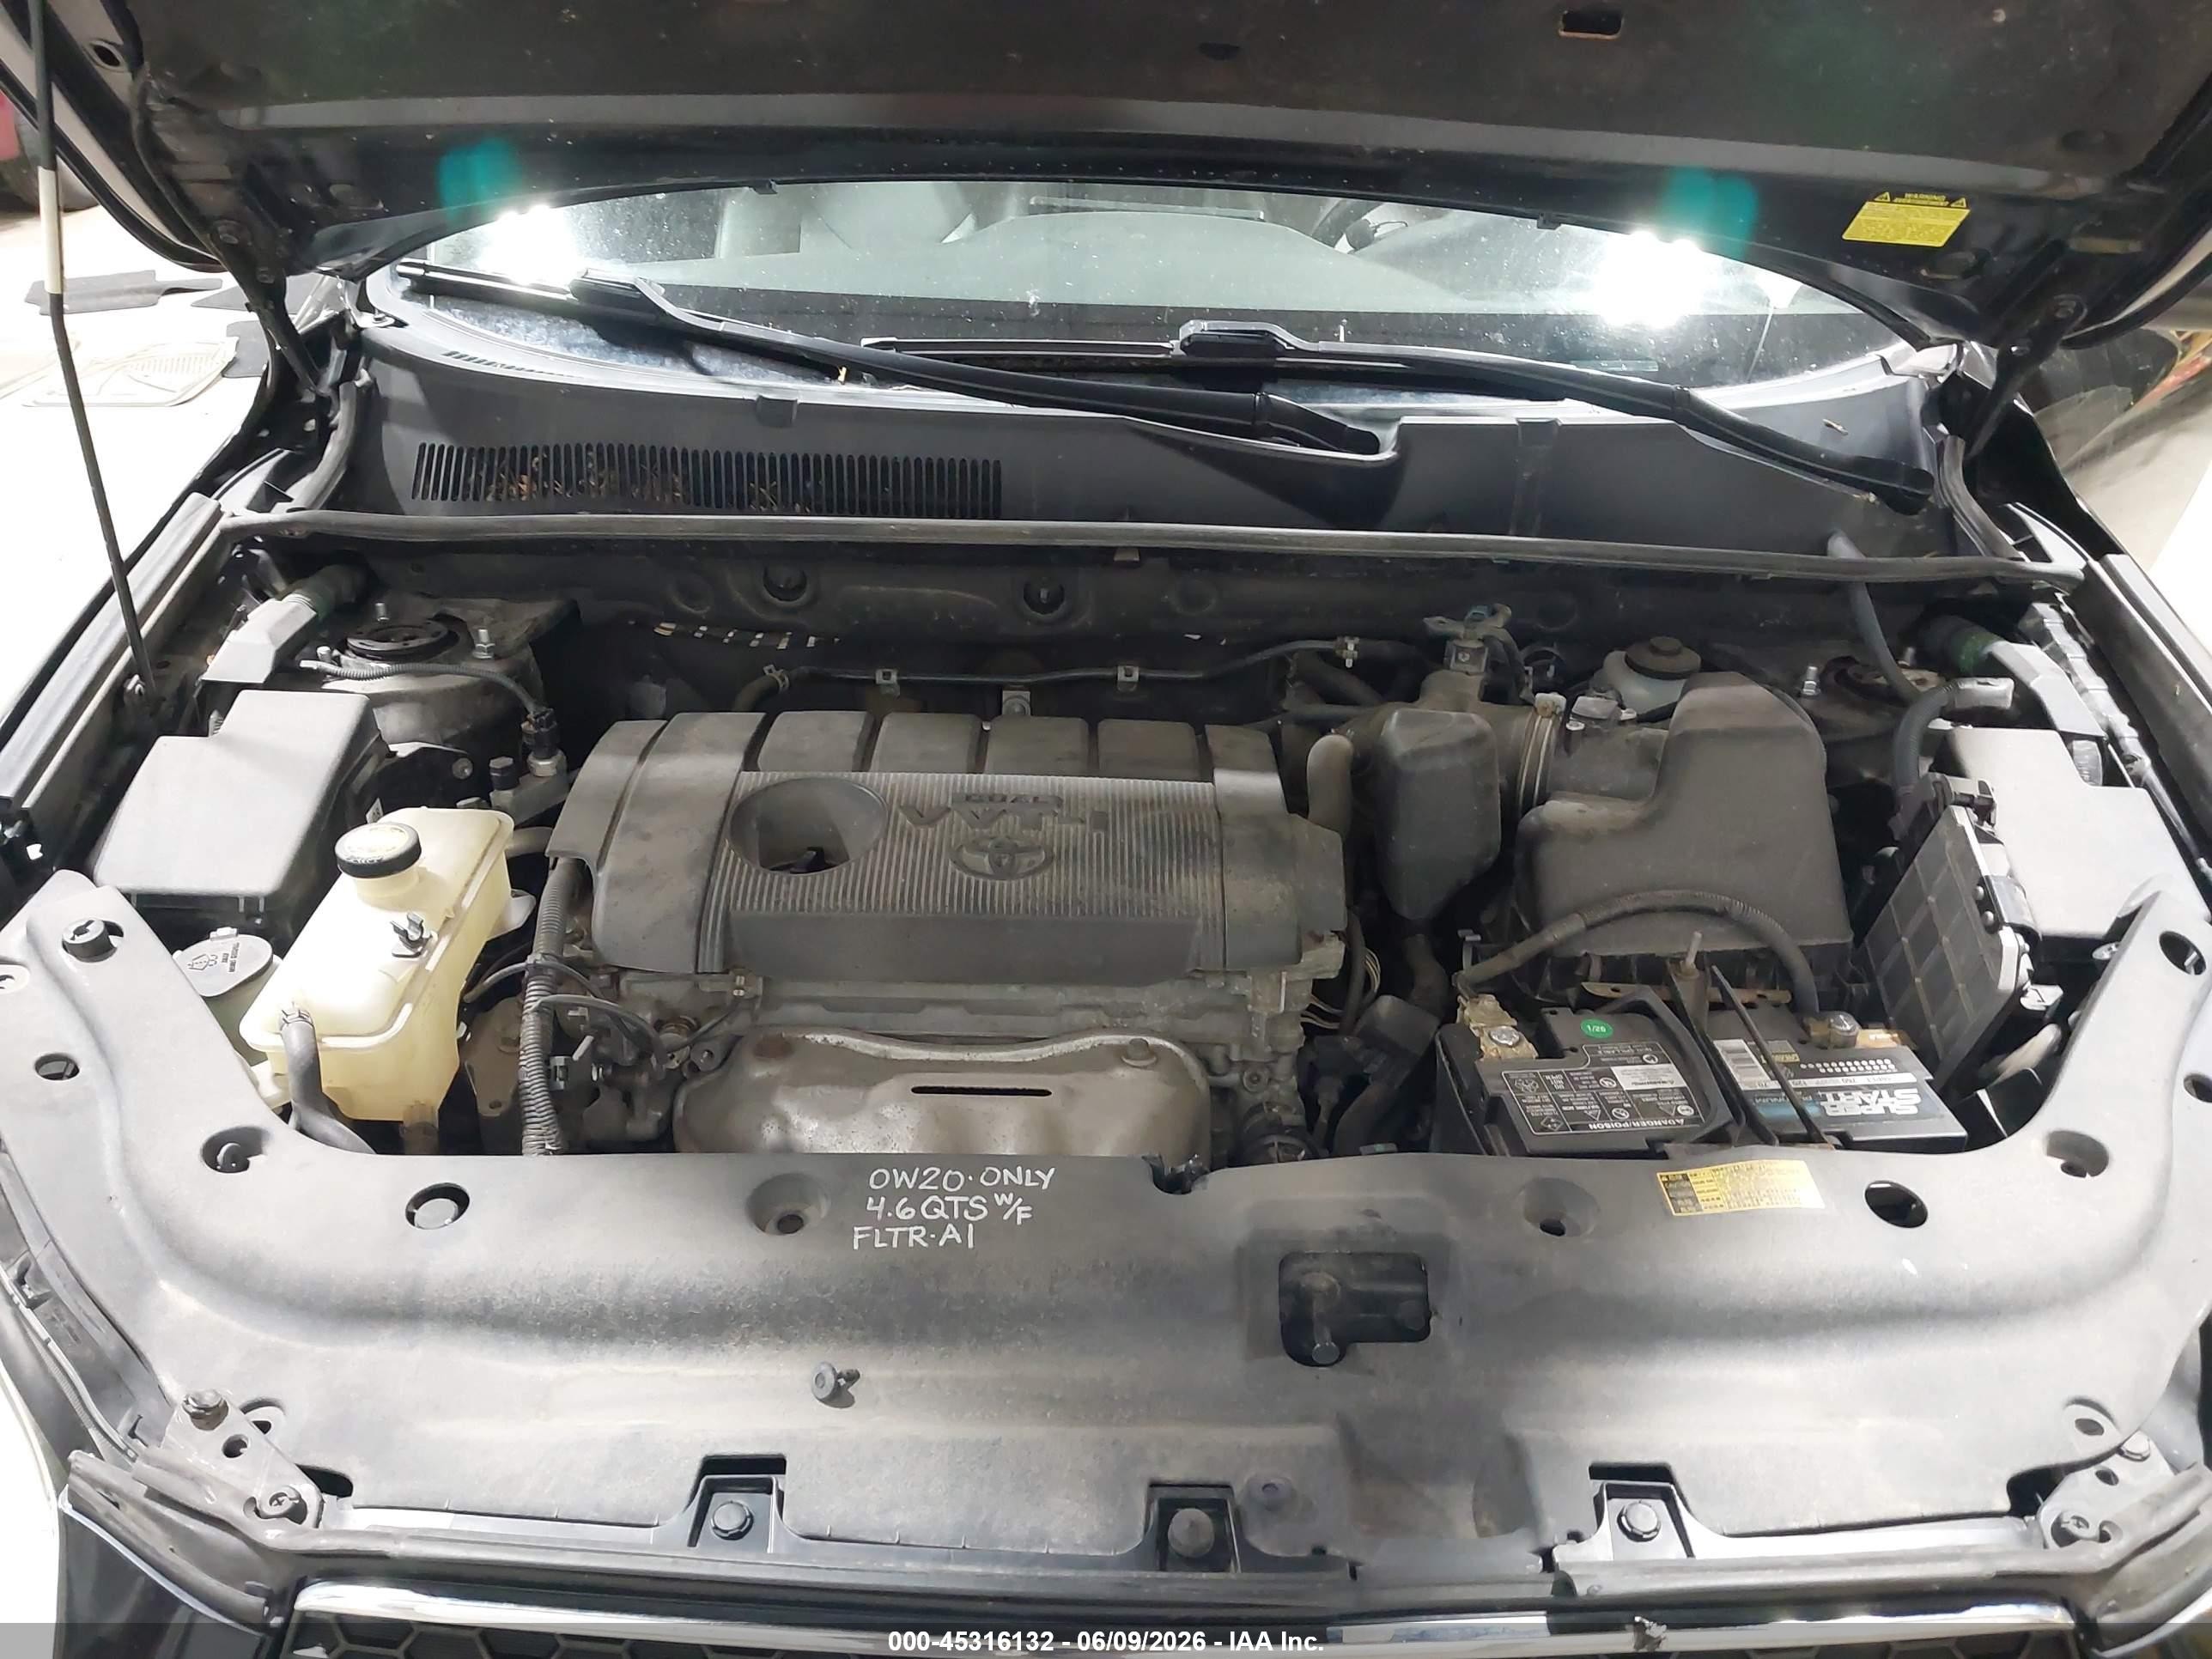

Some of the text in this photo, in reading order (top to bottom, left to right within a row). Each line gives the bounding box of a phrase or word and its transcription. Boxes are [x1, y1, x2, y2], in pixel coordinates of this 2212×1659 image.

[1820, 1089, 1922, 1104] START
[1823, 1103, 1920, 1116] SUPER
[1588, 1118, 1676, 1130] DANGER/POISON
